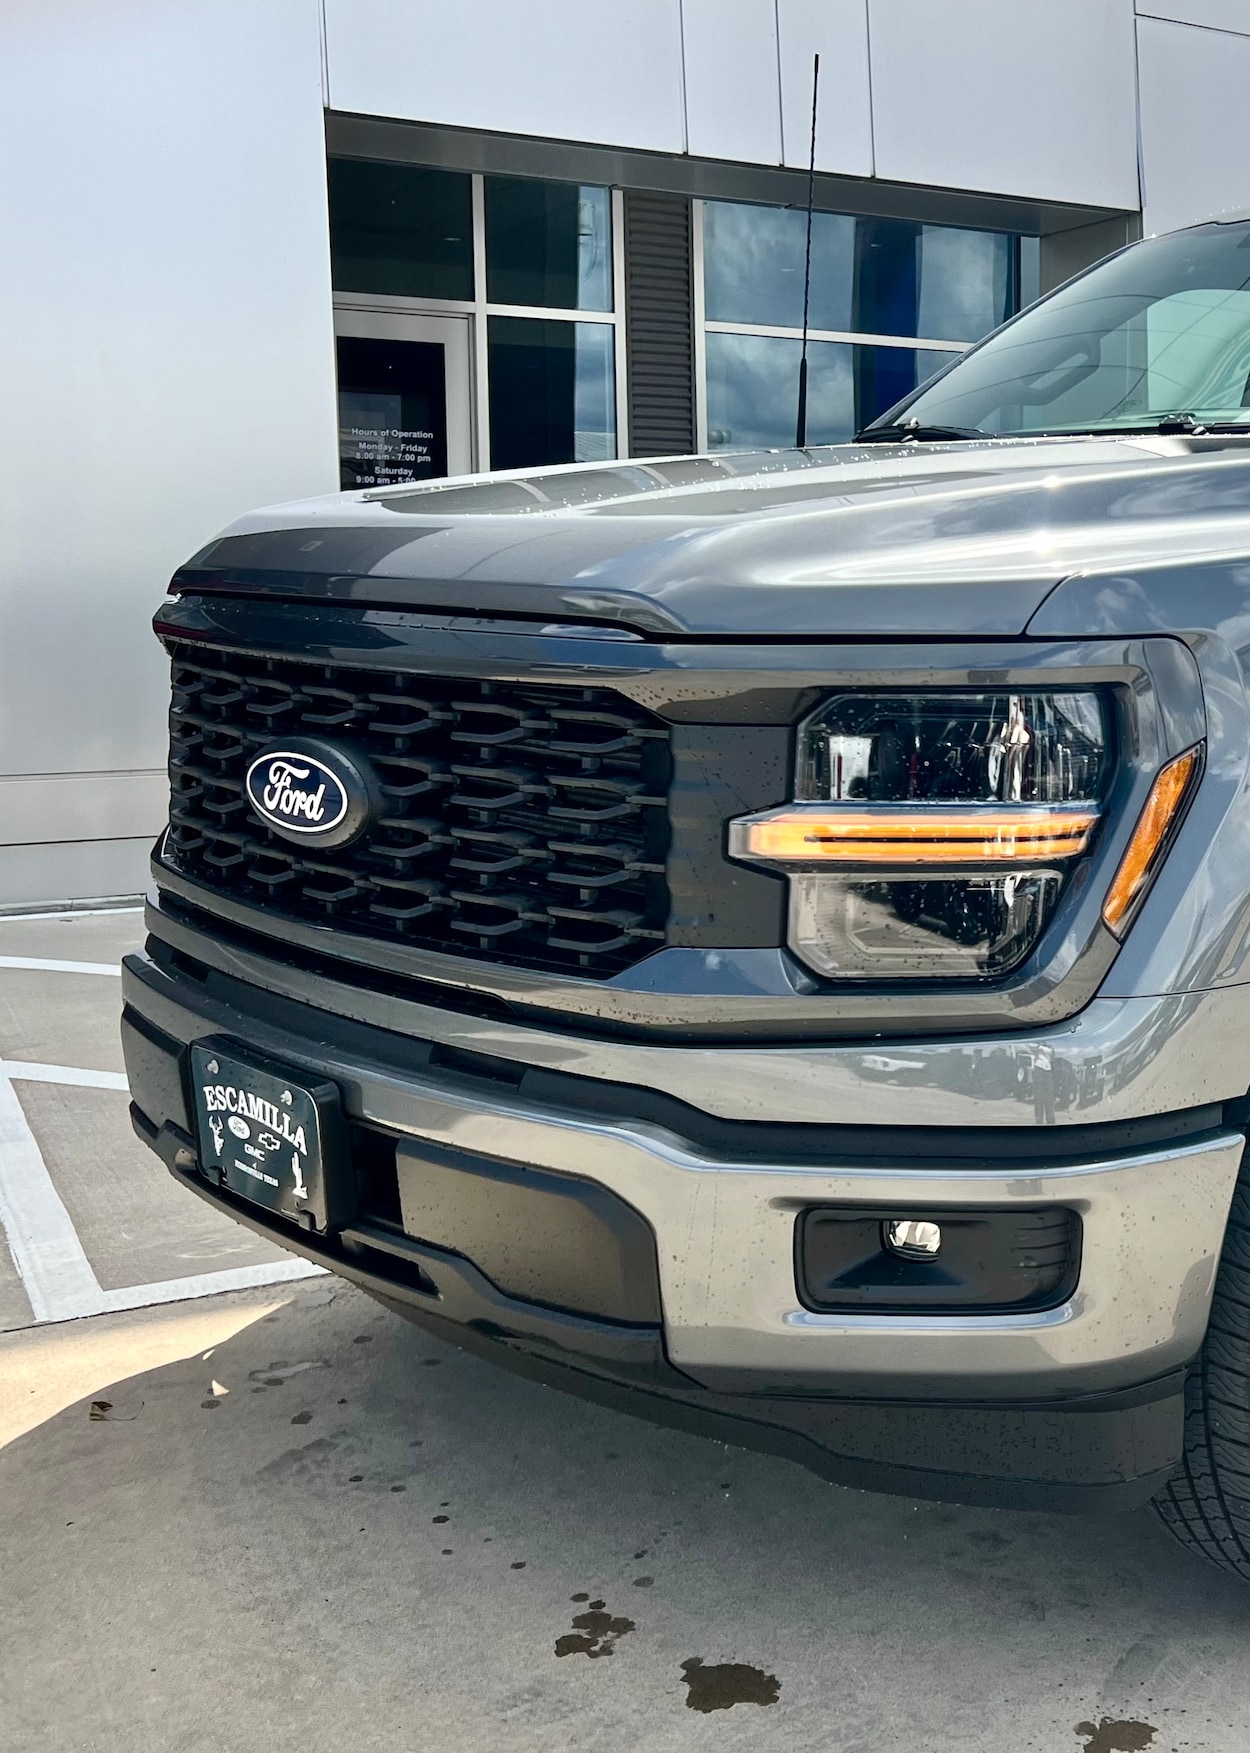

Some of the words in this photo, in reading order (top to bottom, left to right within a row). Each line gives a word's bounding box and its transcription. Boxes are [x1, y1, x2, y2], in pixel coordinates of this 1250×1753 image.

[351, 428, 378, 436] Hours
[391, 430, 433, 439] Operation
[359, 442, 393, 452] Monday
[401, 444, 428, 453] Friday
[397, 453, 415, 461] 7:00
[374, 466, 413, 477] Saturday
[355, 476, 374, 484] 9:00
[263, 761, 326, 821] Ford
[203, 1085, 307, 1156] ESCAMILLA
[244, 1143, 266, 1161] GMC
